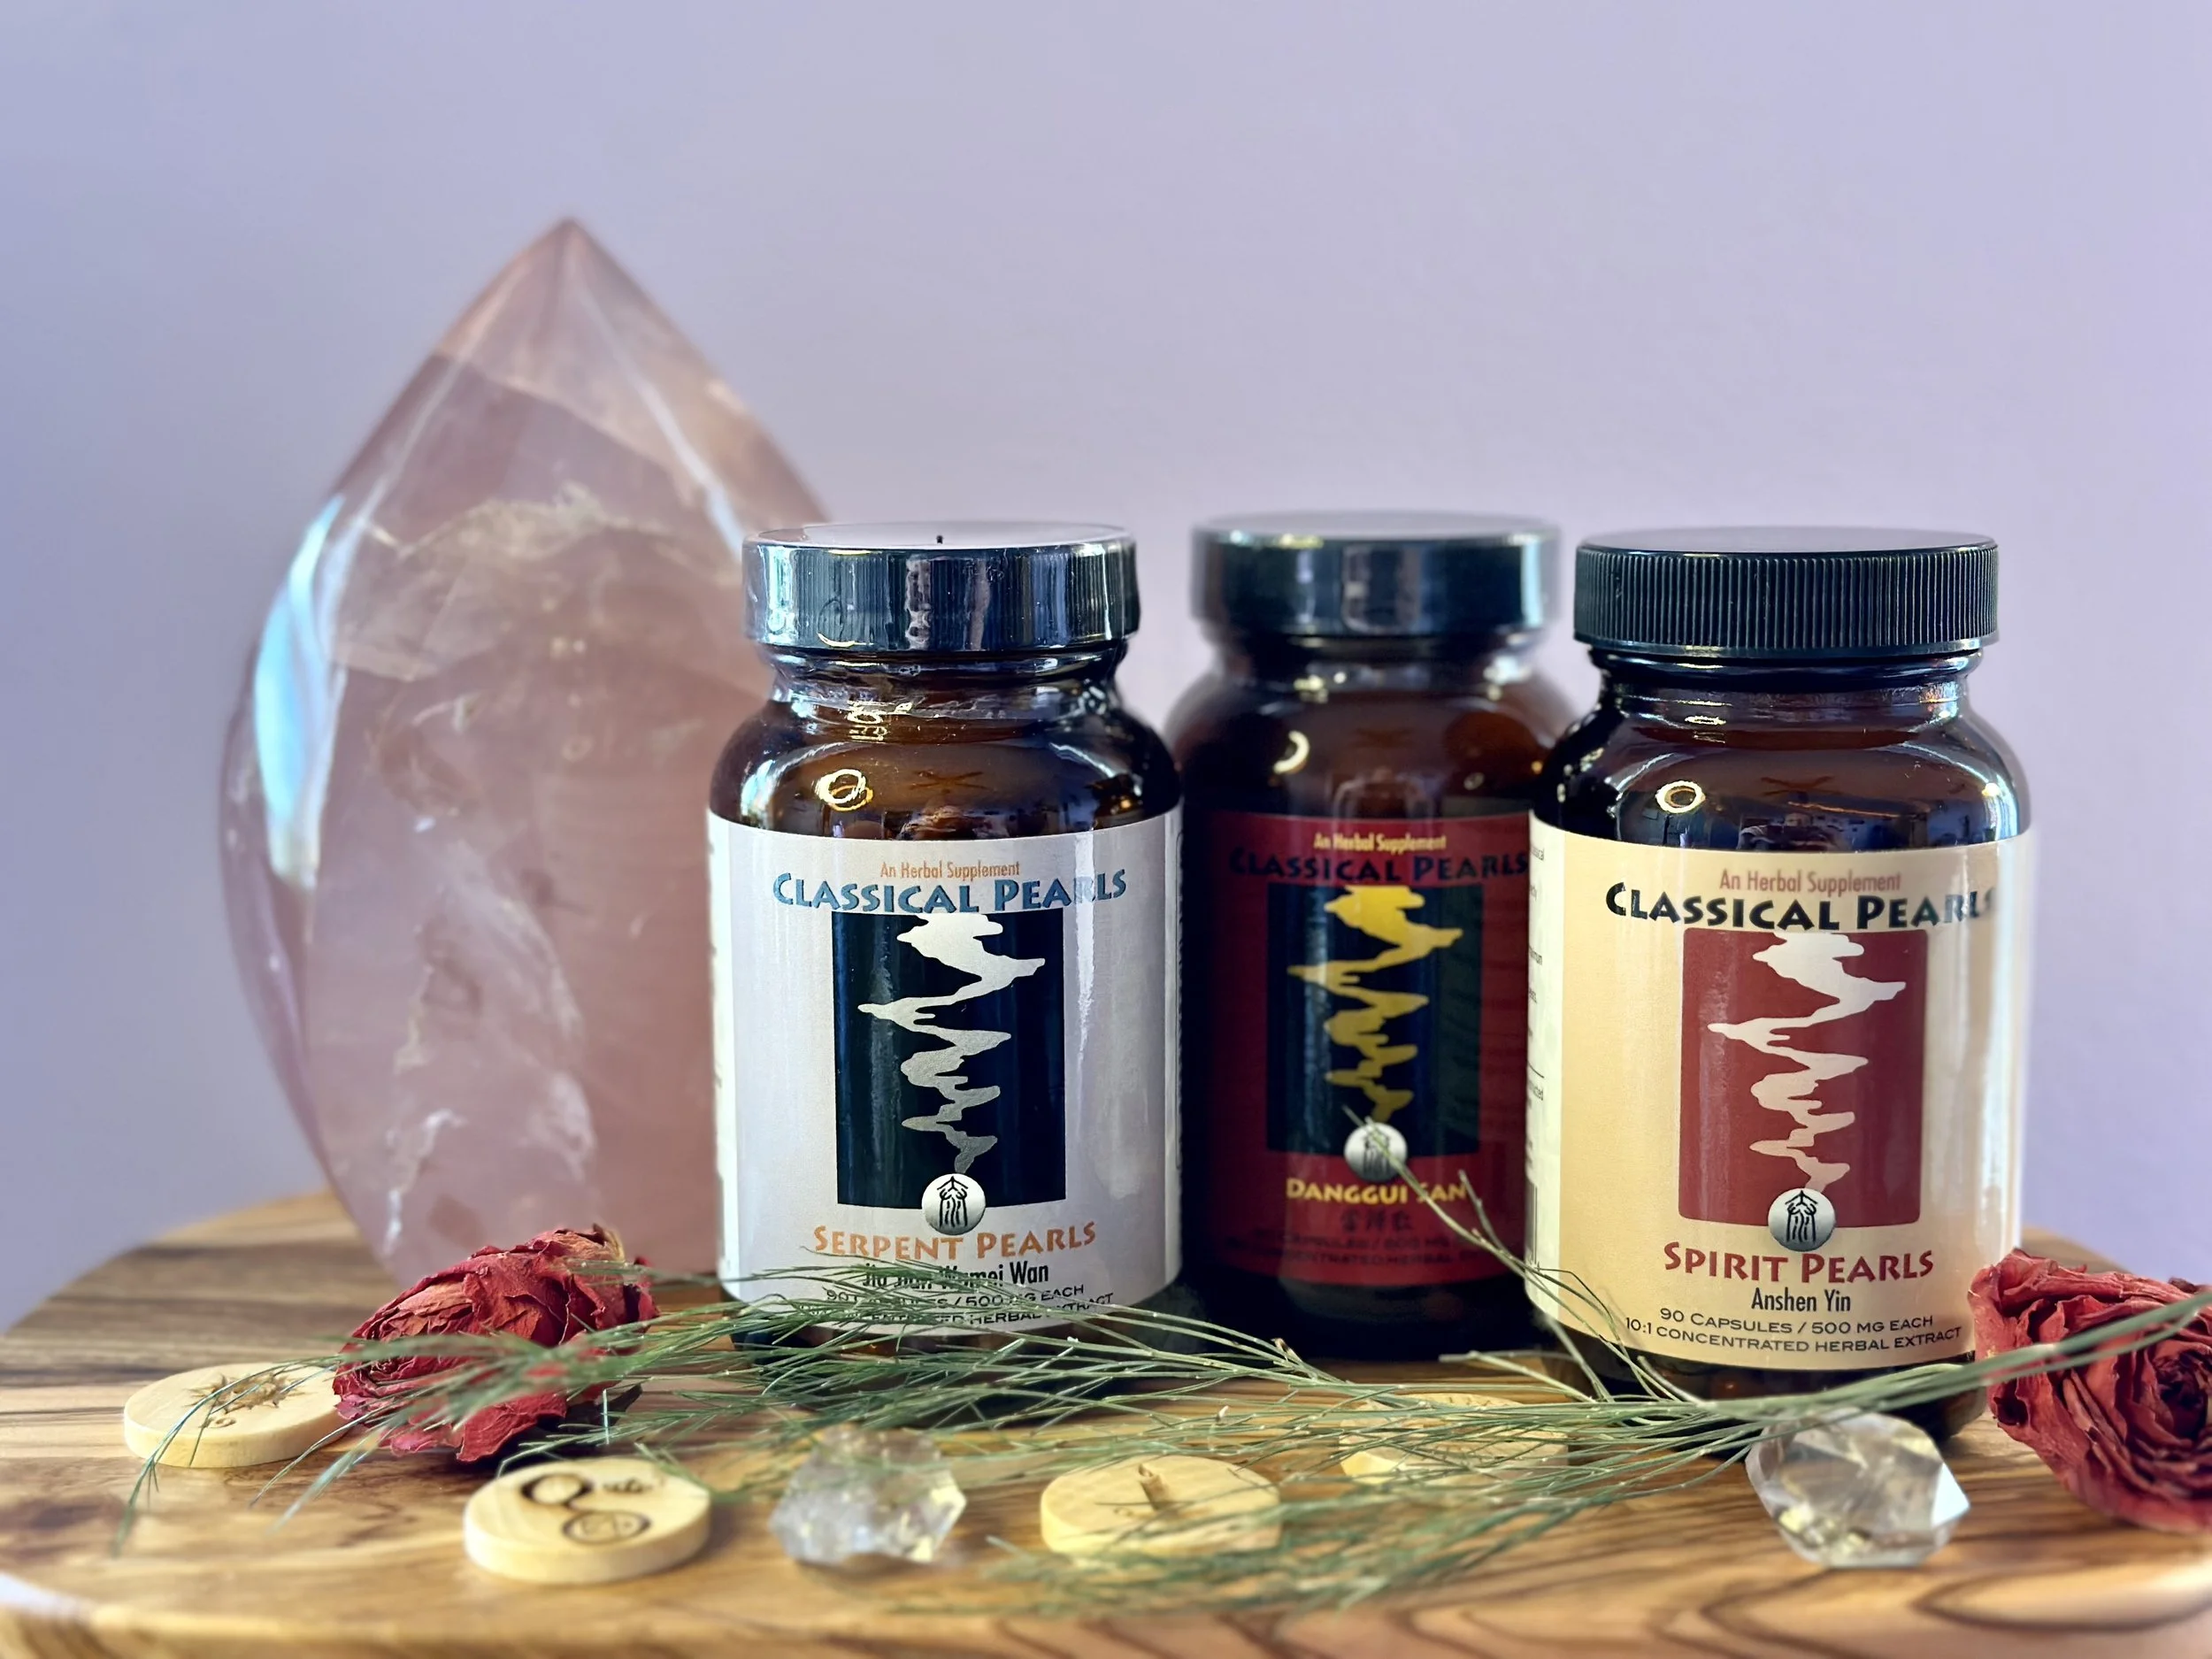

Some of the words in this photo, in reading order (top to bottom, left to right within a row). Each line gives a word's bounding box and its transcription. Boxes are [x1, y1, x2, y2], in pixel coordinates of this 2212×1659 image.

[879, 861, 897, 879] An
[901, 861, 943, 879] Herbal
[947, 861, 1020, 883] Supplement
[1719, 870, 1741, 891] An
[1747, 869, 1802, 894] Herbal
[1808, 871, 1901, 899] Supplement
[773, 872, 979, 914] CLASSICAL
[1606, 881, 1839, 931] CLASSICAL
[1286, 1178, 1408, 1205] DANGGUI
[814, 1225, 964, 1261] SERPENT
[977, 1221, 1097, 1259] PEARLS
[1010, 1260, 1049, 1286] Wan
[1663, 1240, 1788, 1282] SPIRIT
[1801, 1249, 1934, 1283] PEARLS
[966, 1294, 1003, 1308] 500
[1041, 1284, 1084, 1302] EACH
[1751, 1287, 1817, 1312] Anshen
[1824, 1289, 1851, 1312] Yin
[1625, 1317, 1652, 1334] 10:1
[1656, 1325, 1809, 1352] CONCENTRATED
[1815, 1336, 1890, 1352] HERBAL
[1893, 1325, 1962, 1348] EXTRACT
[1660, 1308, 1685, 1322] 90
[1690, 1312, 1793, 1333] CAPSULES
[1811, 1320, 1851, 1333] 500
[1856, 1319, 1885, 1333] MG
[1889, 1315, 1933, 1332] EACH
